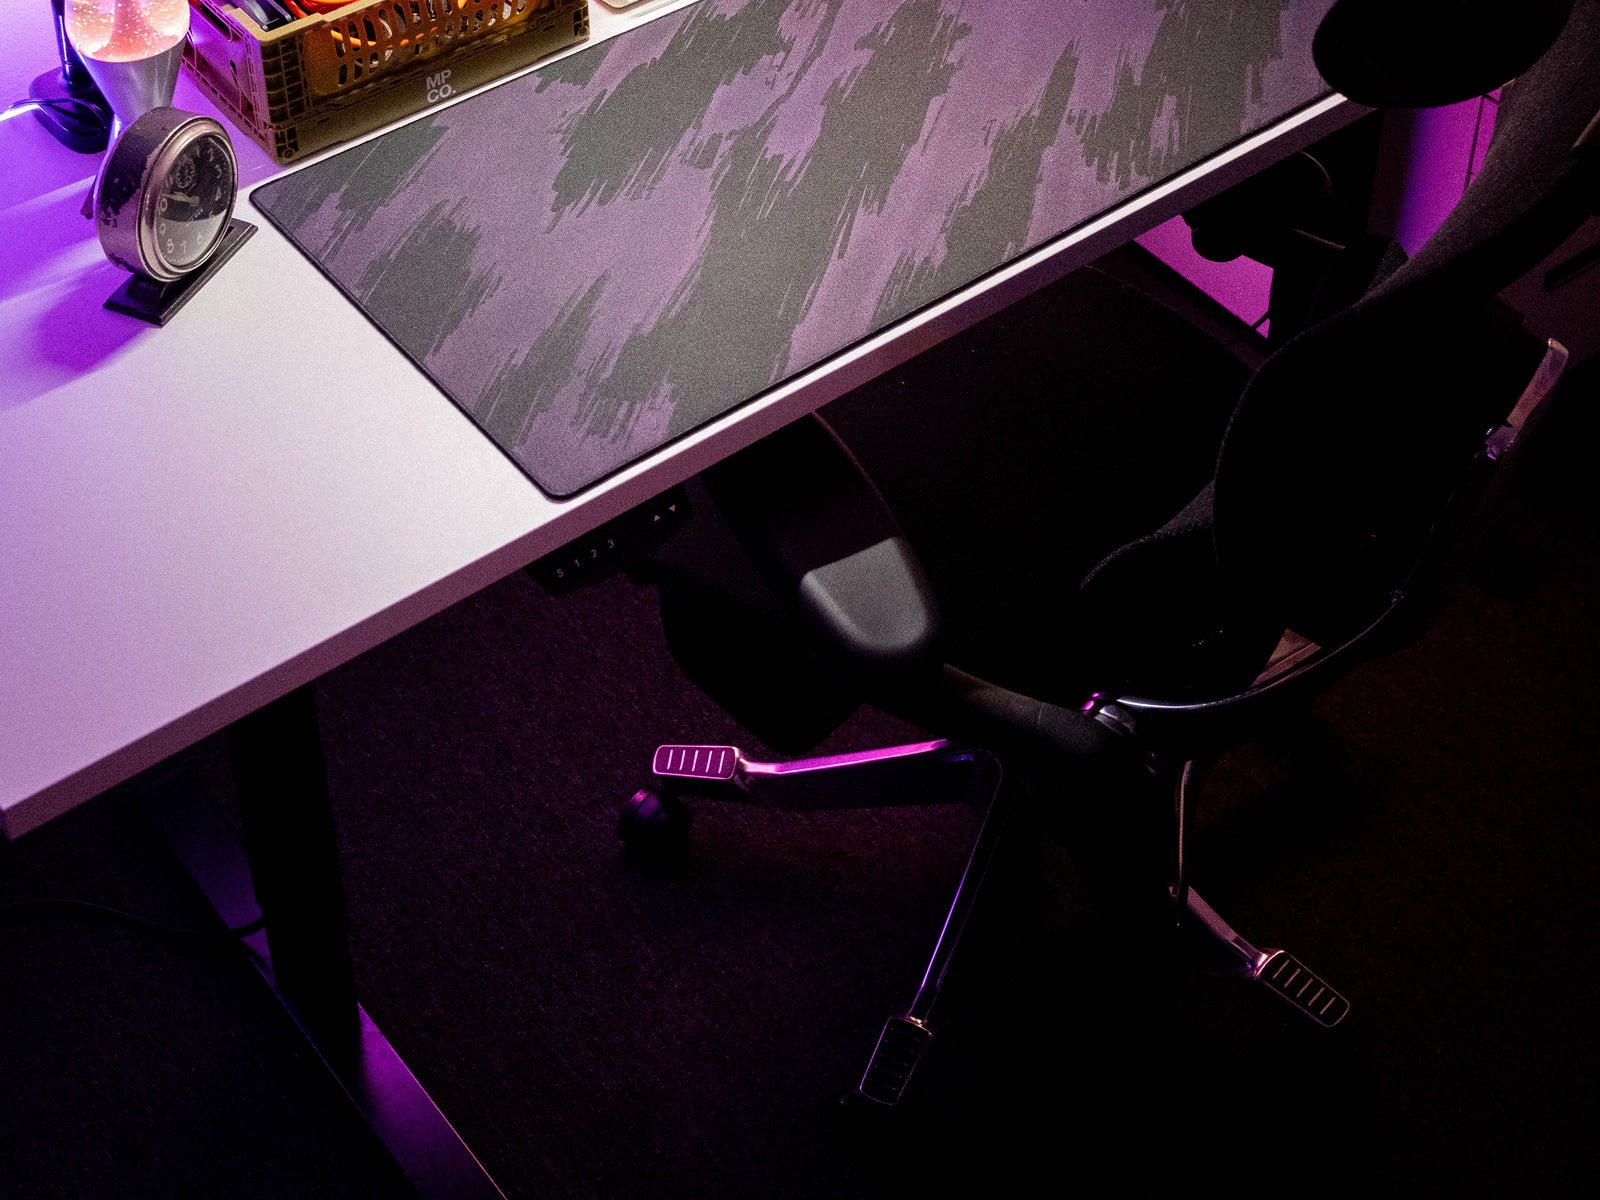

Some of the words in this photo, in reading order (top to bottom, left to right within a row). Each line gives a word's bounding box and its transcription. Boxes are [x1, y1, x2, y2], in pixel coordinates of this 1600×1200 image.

[426, 69, 452, 90] MP
[427, 83, 457, 103] CO.
[214, 163, 222, 179] 3
[166, 238, 174, 254] 8
[590, 549, 598, 559] 2
